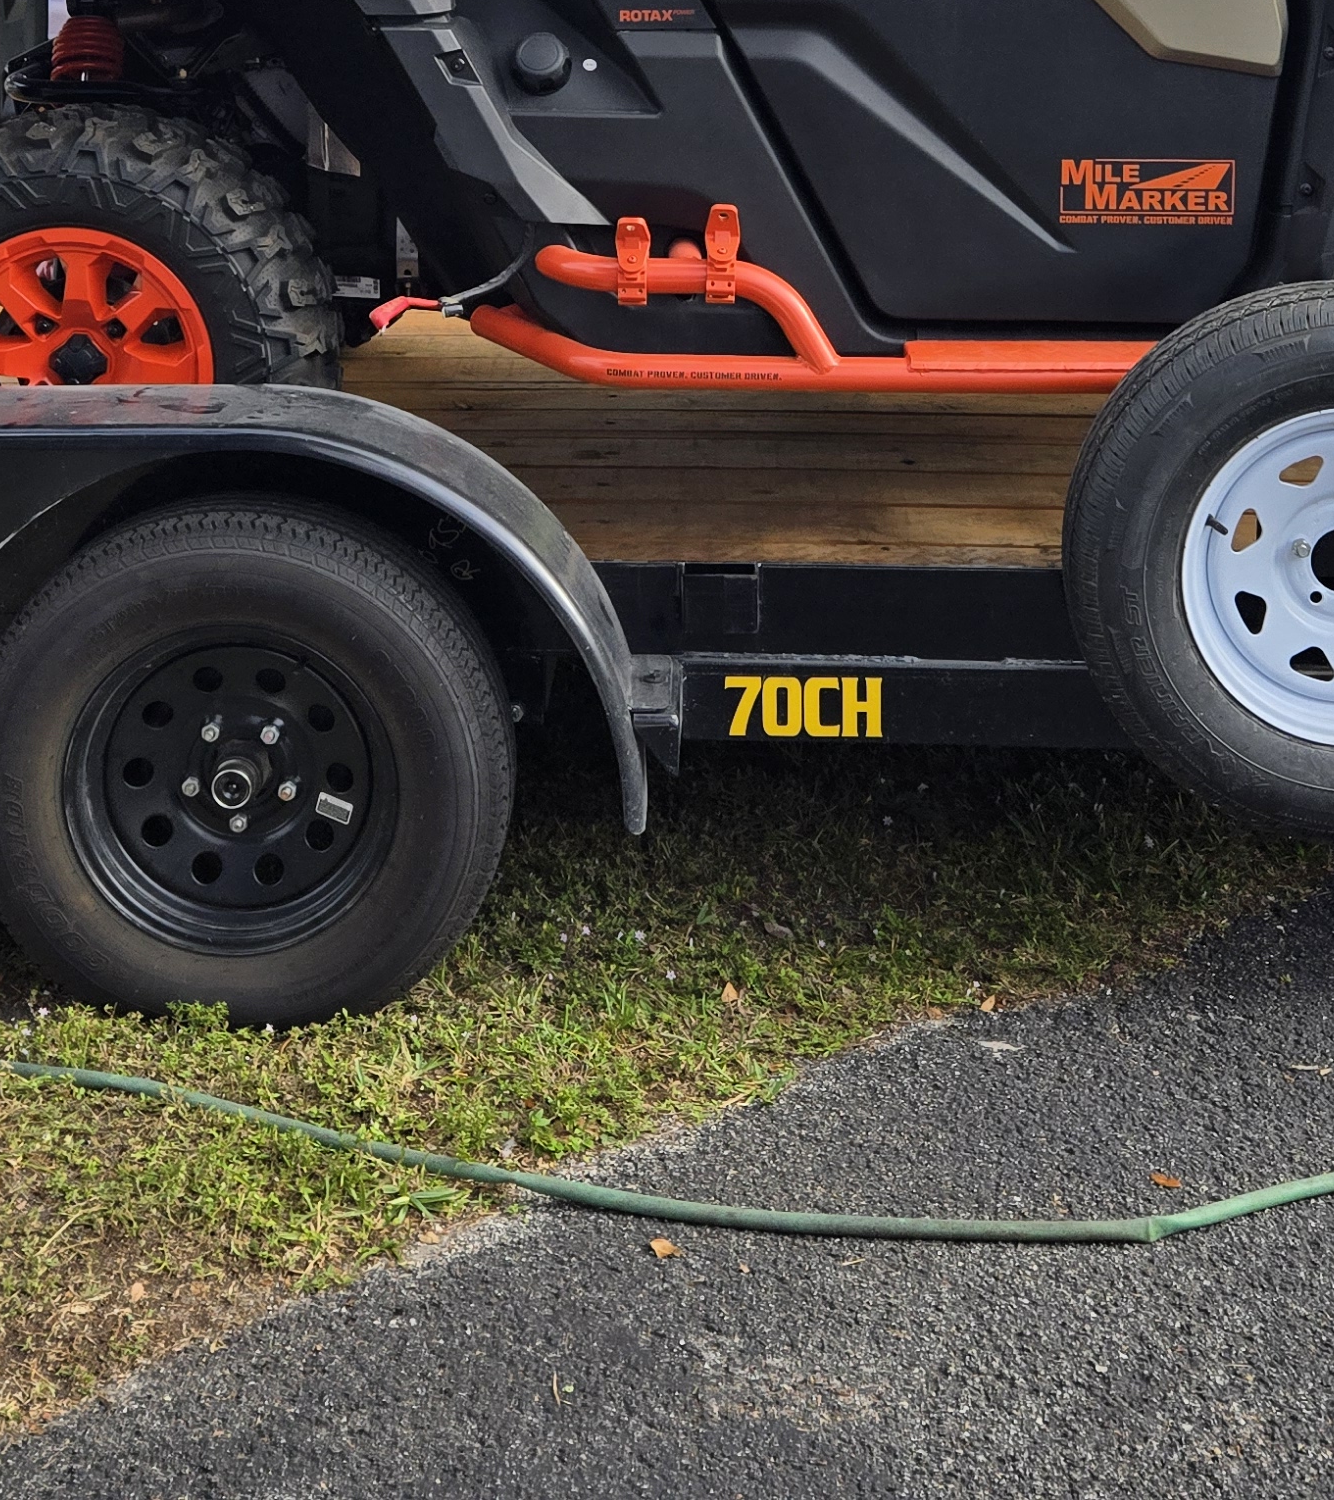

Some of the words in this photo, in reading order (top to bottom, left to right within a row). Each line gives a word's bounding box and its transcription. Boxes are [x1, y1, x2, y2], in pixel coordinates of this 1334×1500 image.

[619, 9, 673, 22] ROTAX
[1059, 215, 1099, 224] COMBAT
[1144, 216, 1196, 225] CUSTOMER
[606, 368, 645, 378] COMBAT
[690, 371, 742, 381] CUSTOMER
[724, 675, 884, 738] 70CH
